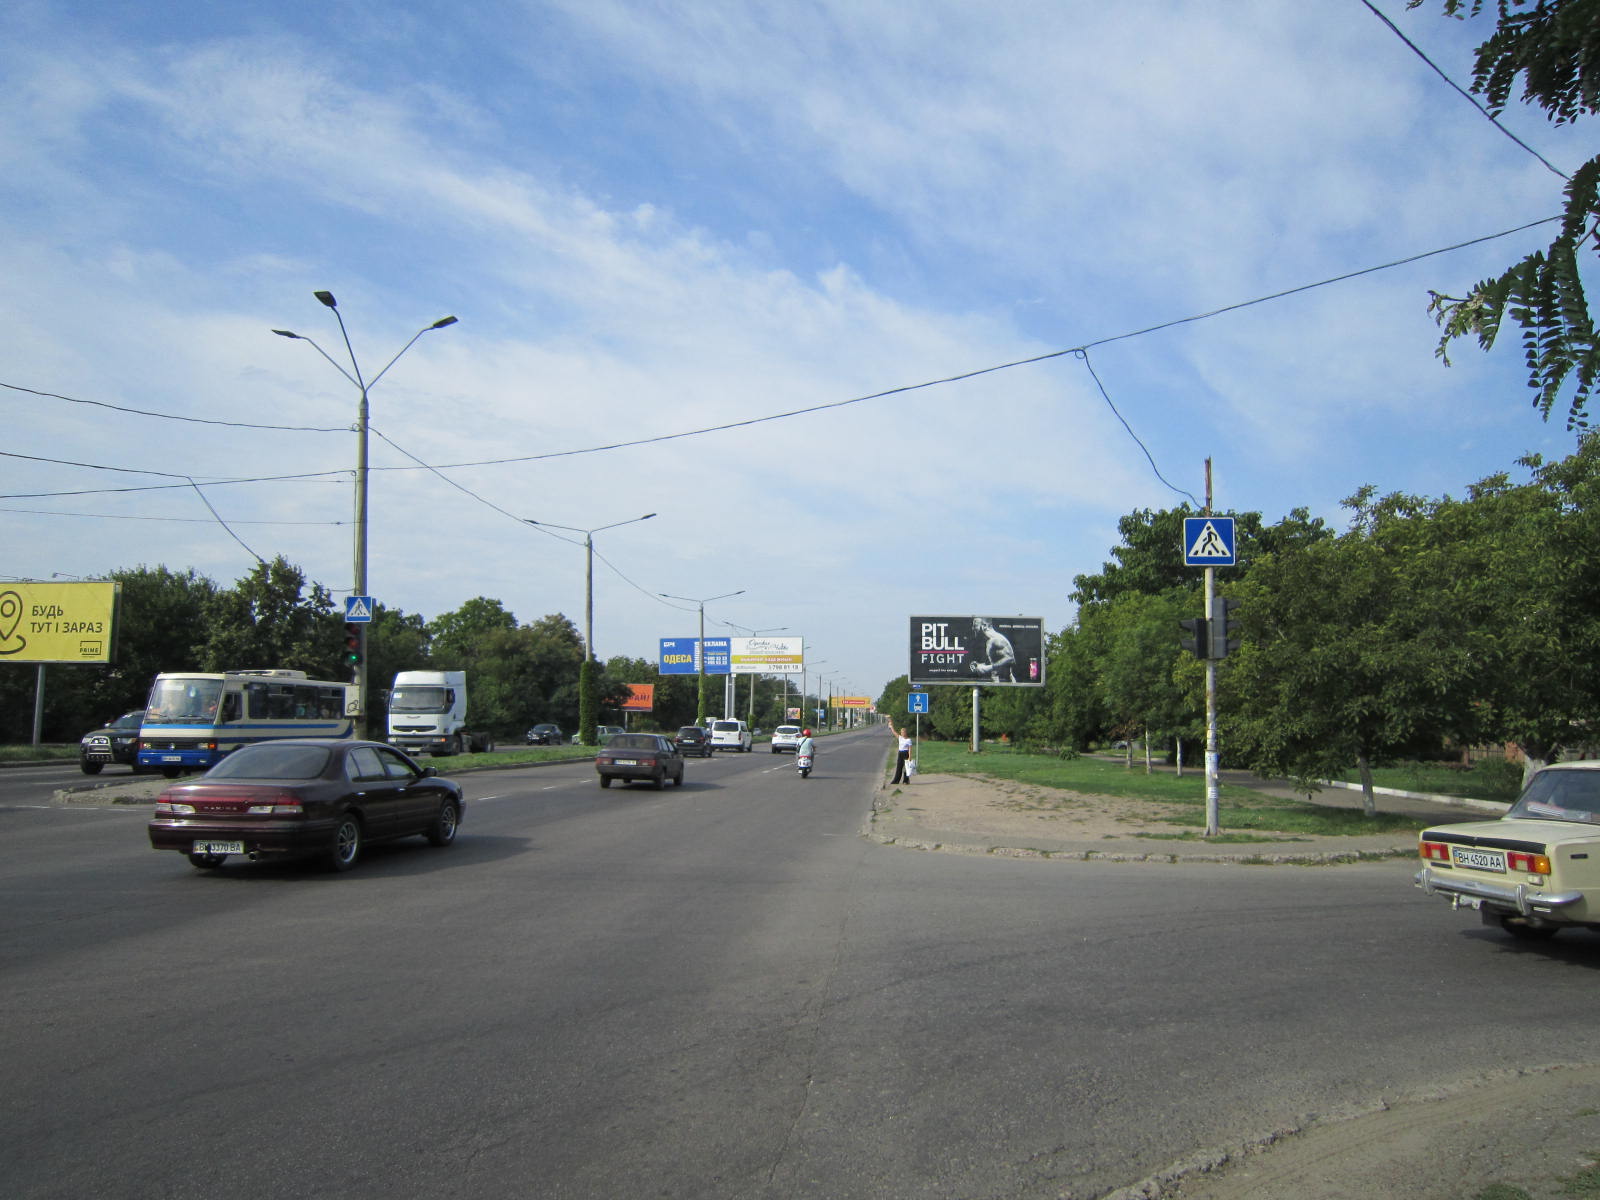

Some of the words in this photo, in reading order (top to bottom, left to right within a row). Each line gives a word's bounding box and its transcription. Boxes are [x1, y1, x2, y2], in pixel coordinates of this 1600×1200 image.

[31, 605, 64, 619] БУДЬ
[30, 622, 52, 633] ТУТ
[62, 622, 103, 633] ЗАРАЗ
[921, 623, 949, 636] PIT
[921, 636, 965, 651] BULL
[663, 654, 692, 665] ОДЕСА
[921, 653, 965, 664] FIGHT
[1459, 853, 1469, 864] BH
[1471, 855, 1488, 866] 4520
[1490, 857, 1501, 868] AA
